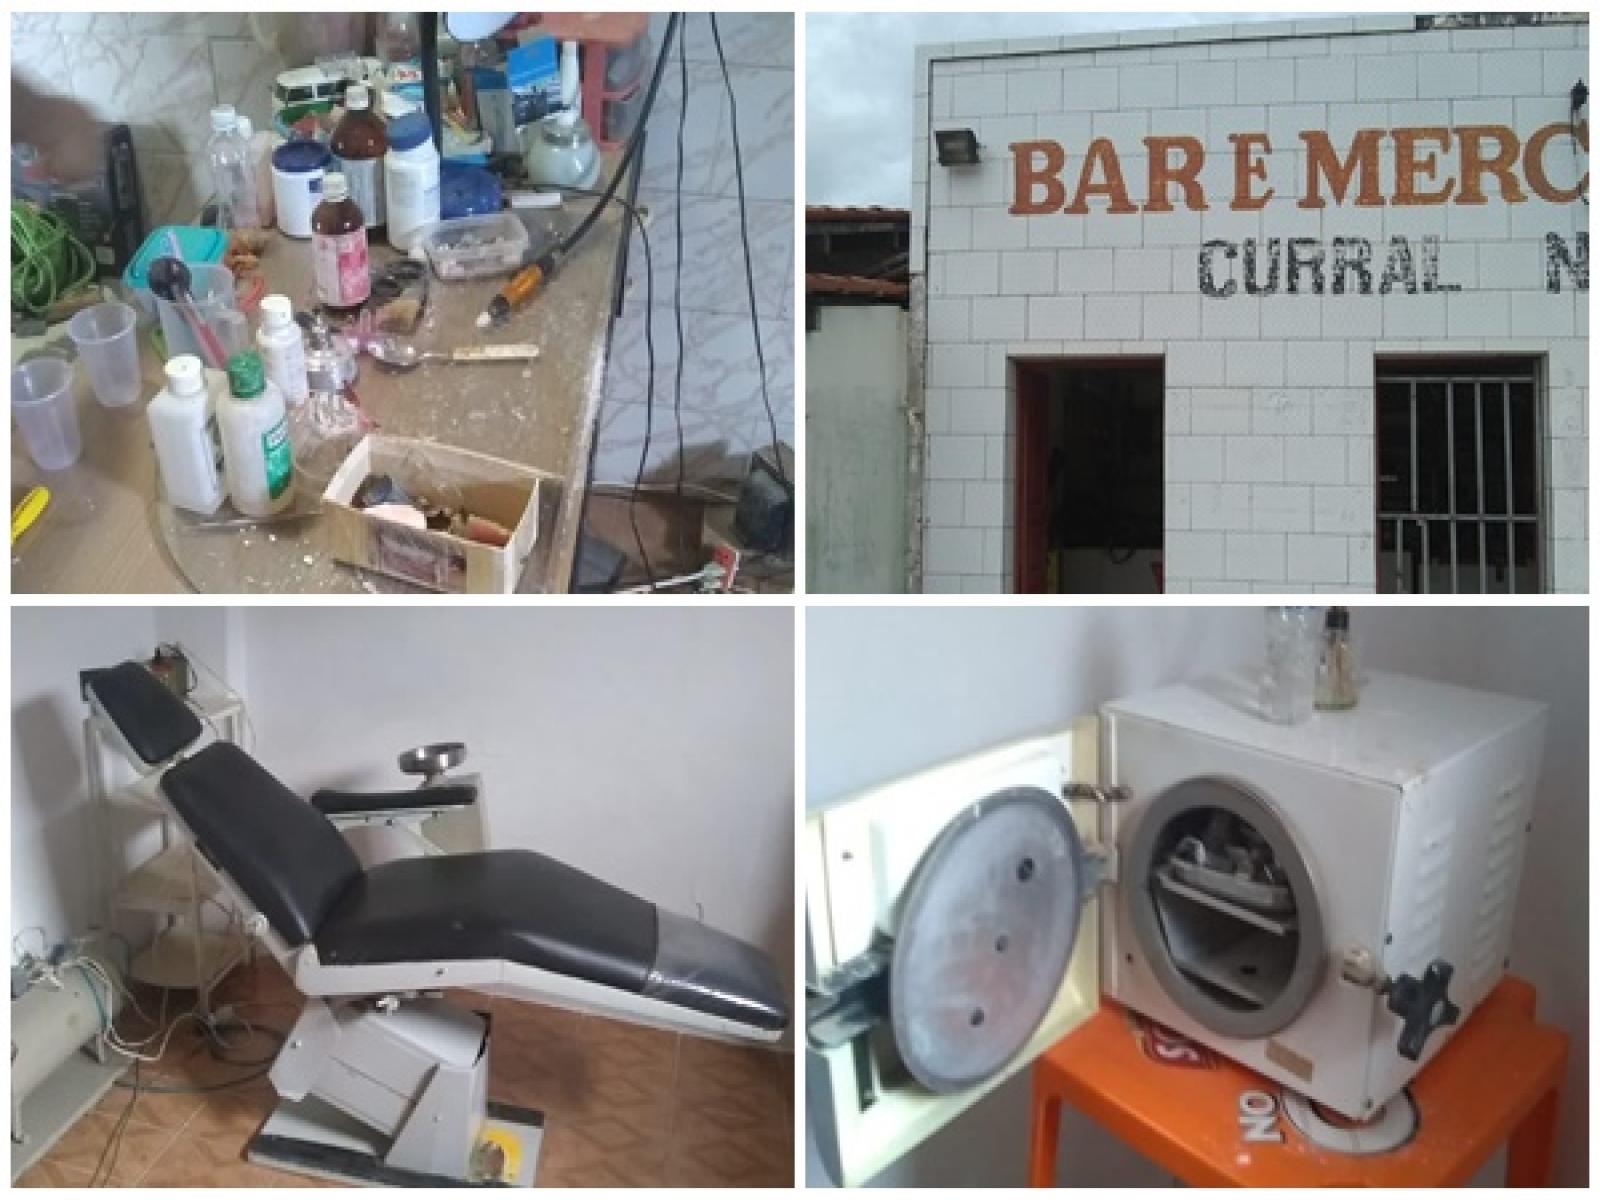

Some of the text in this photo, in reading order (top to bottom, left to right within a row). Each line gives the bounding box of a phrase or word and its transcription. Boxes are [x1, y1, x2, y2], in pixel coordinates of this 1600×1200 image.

[1007, 122, 1589, 214] BAR E MERC
[1197, 231, 1589, 298] CURRAL N
[1238, 1089, 1284, 1143] NO
